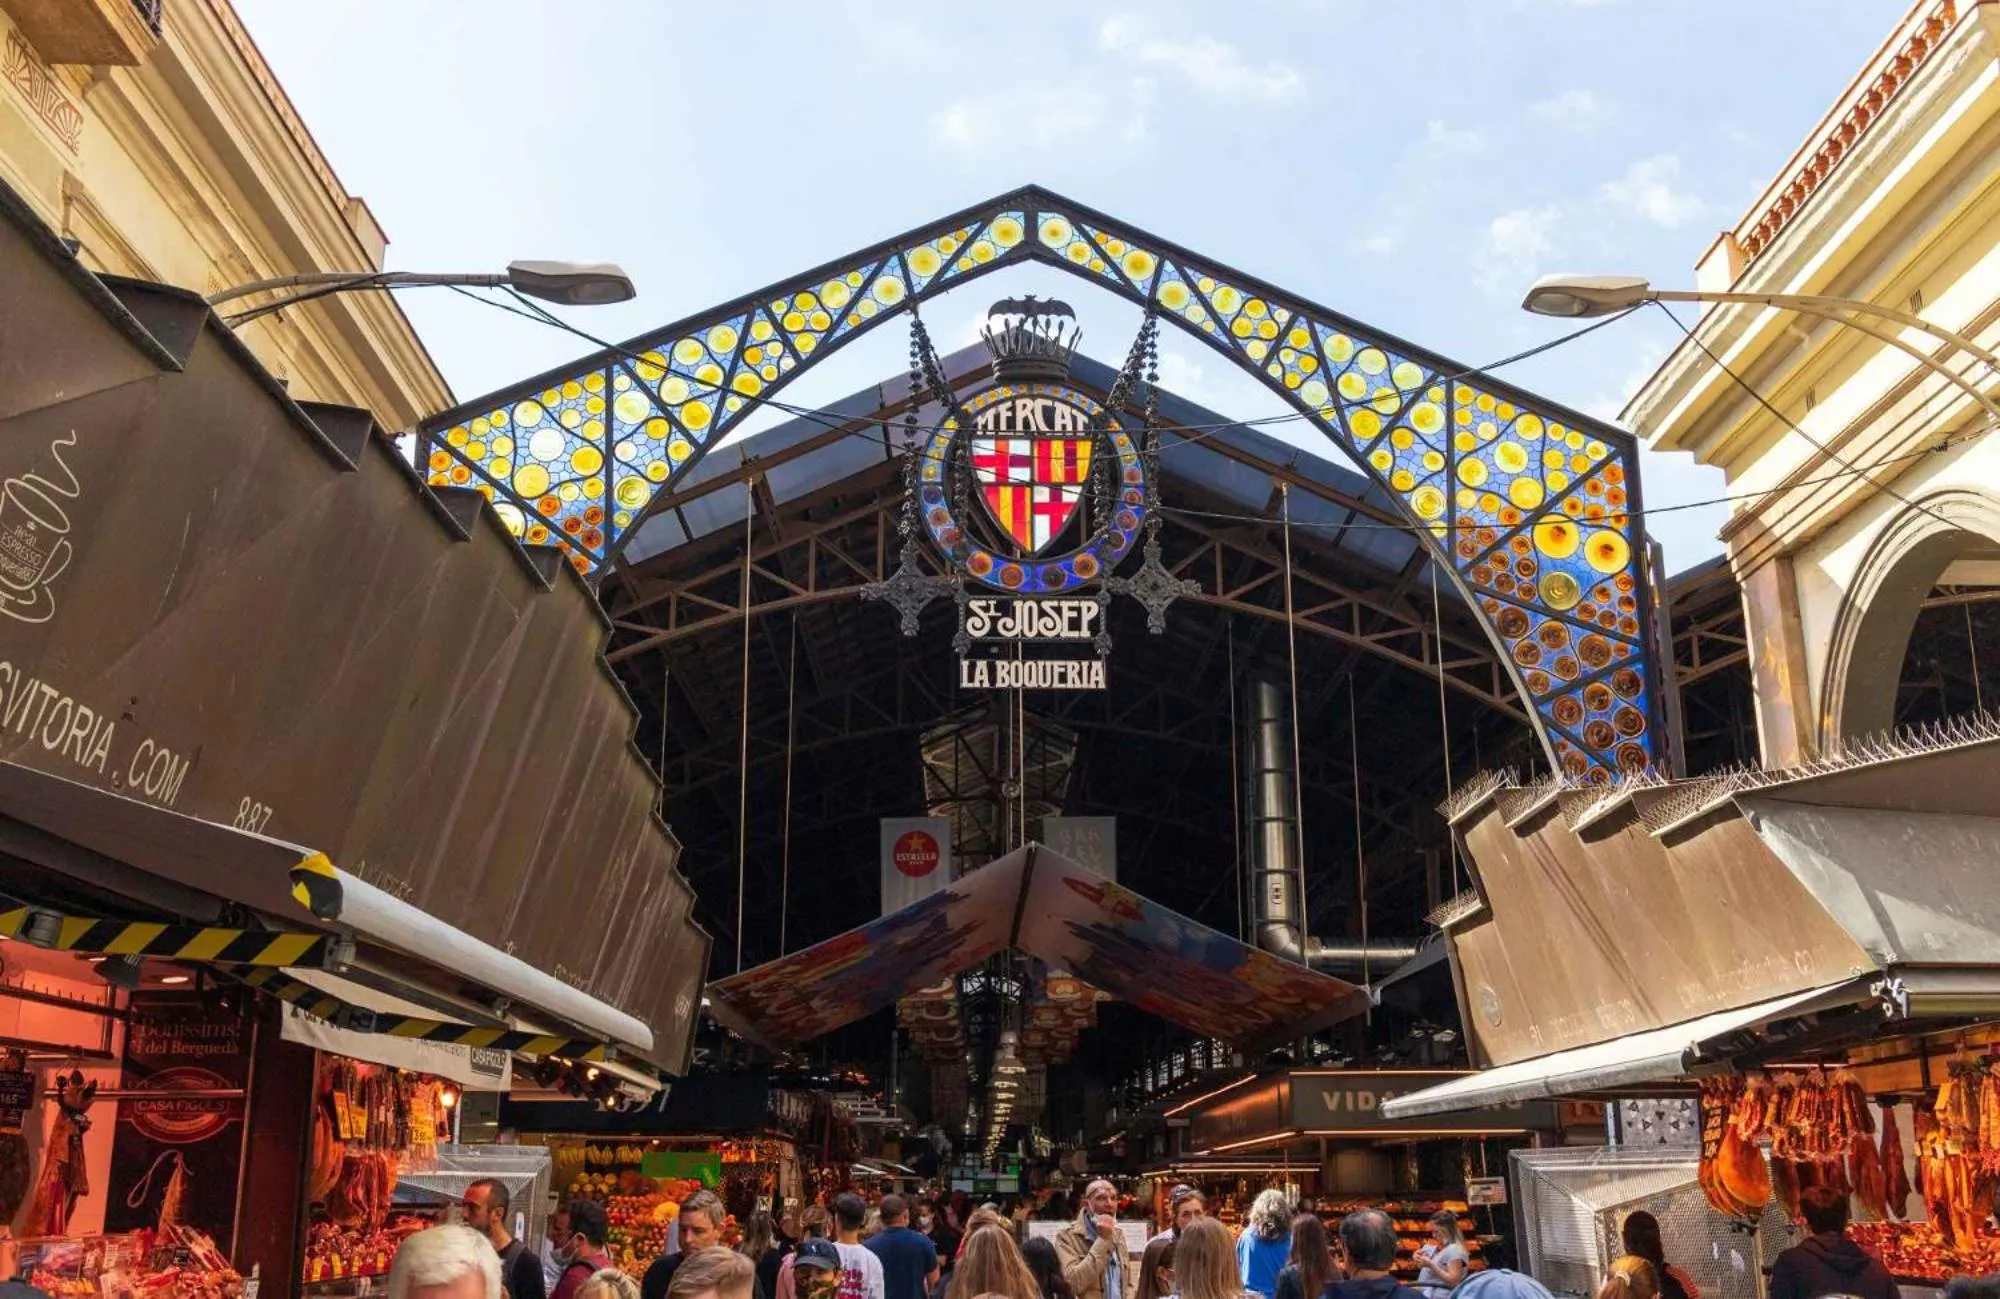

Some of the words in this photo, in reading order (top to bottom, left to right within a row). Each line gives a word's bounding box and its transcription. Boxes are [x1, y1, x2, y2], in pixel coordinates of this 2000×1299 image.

[976, 399, 1091, 434] MERCAT
[997, 600, 1099, 637] JOSEP
[960, 660, 989, 689] LA
[996, 659, 1107, 689] BOQUERIA
[233, 796, 273, 833] 887
[896, 852, 937, 861] ESTRELLA
